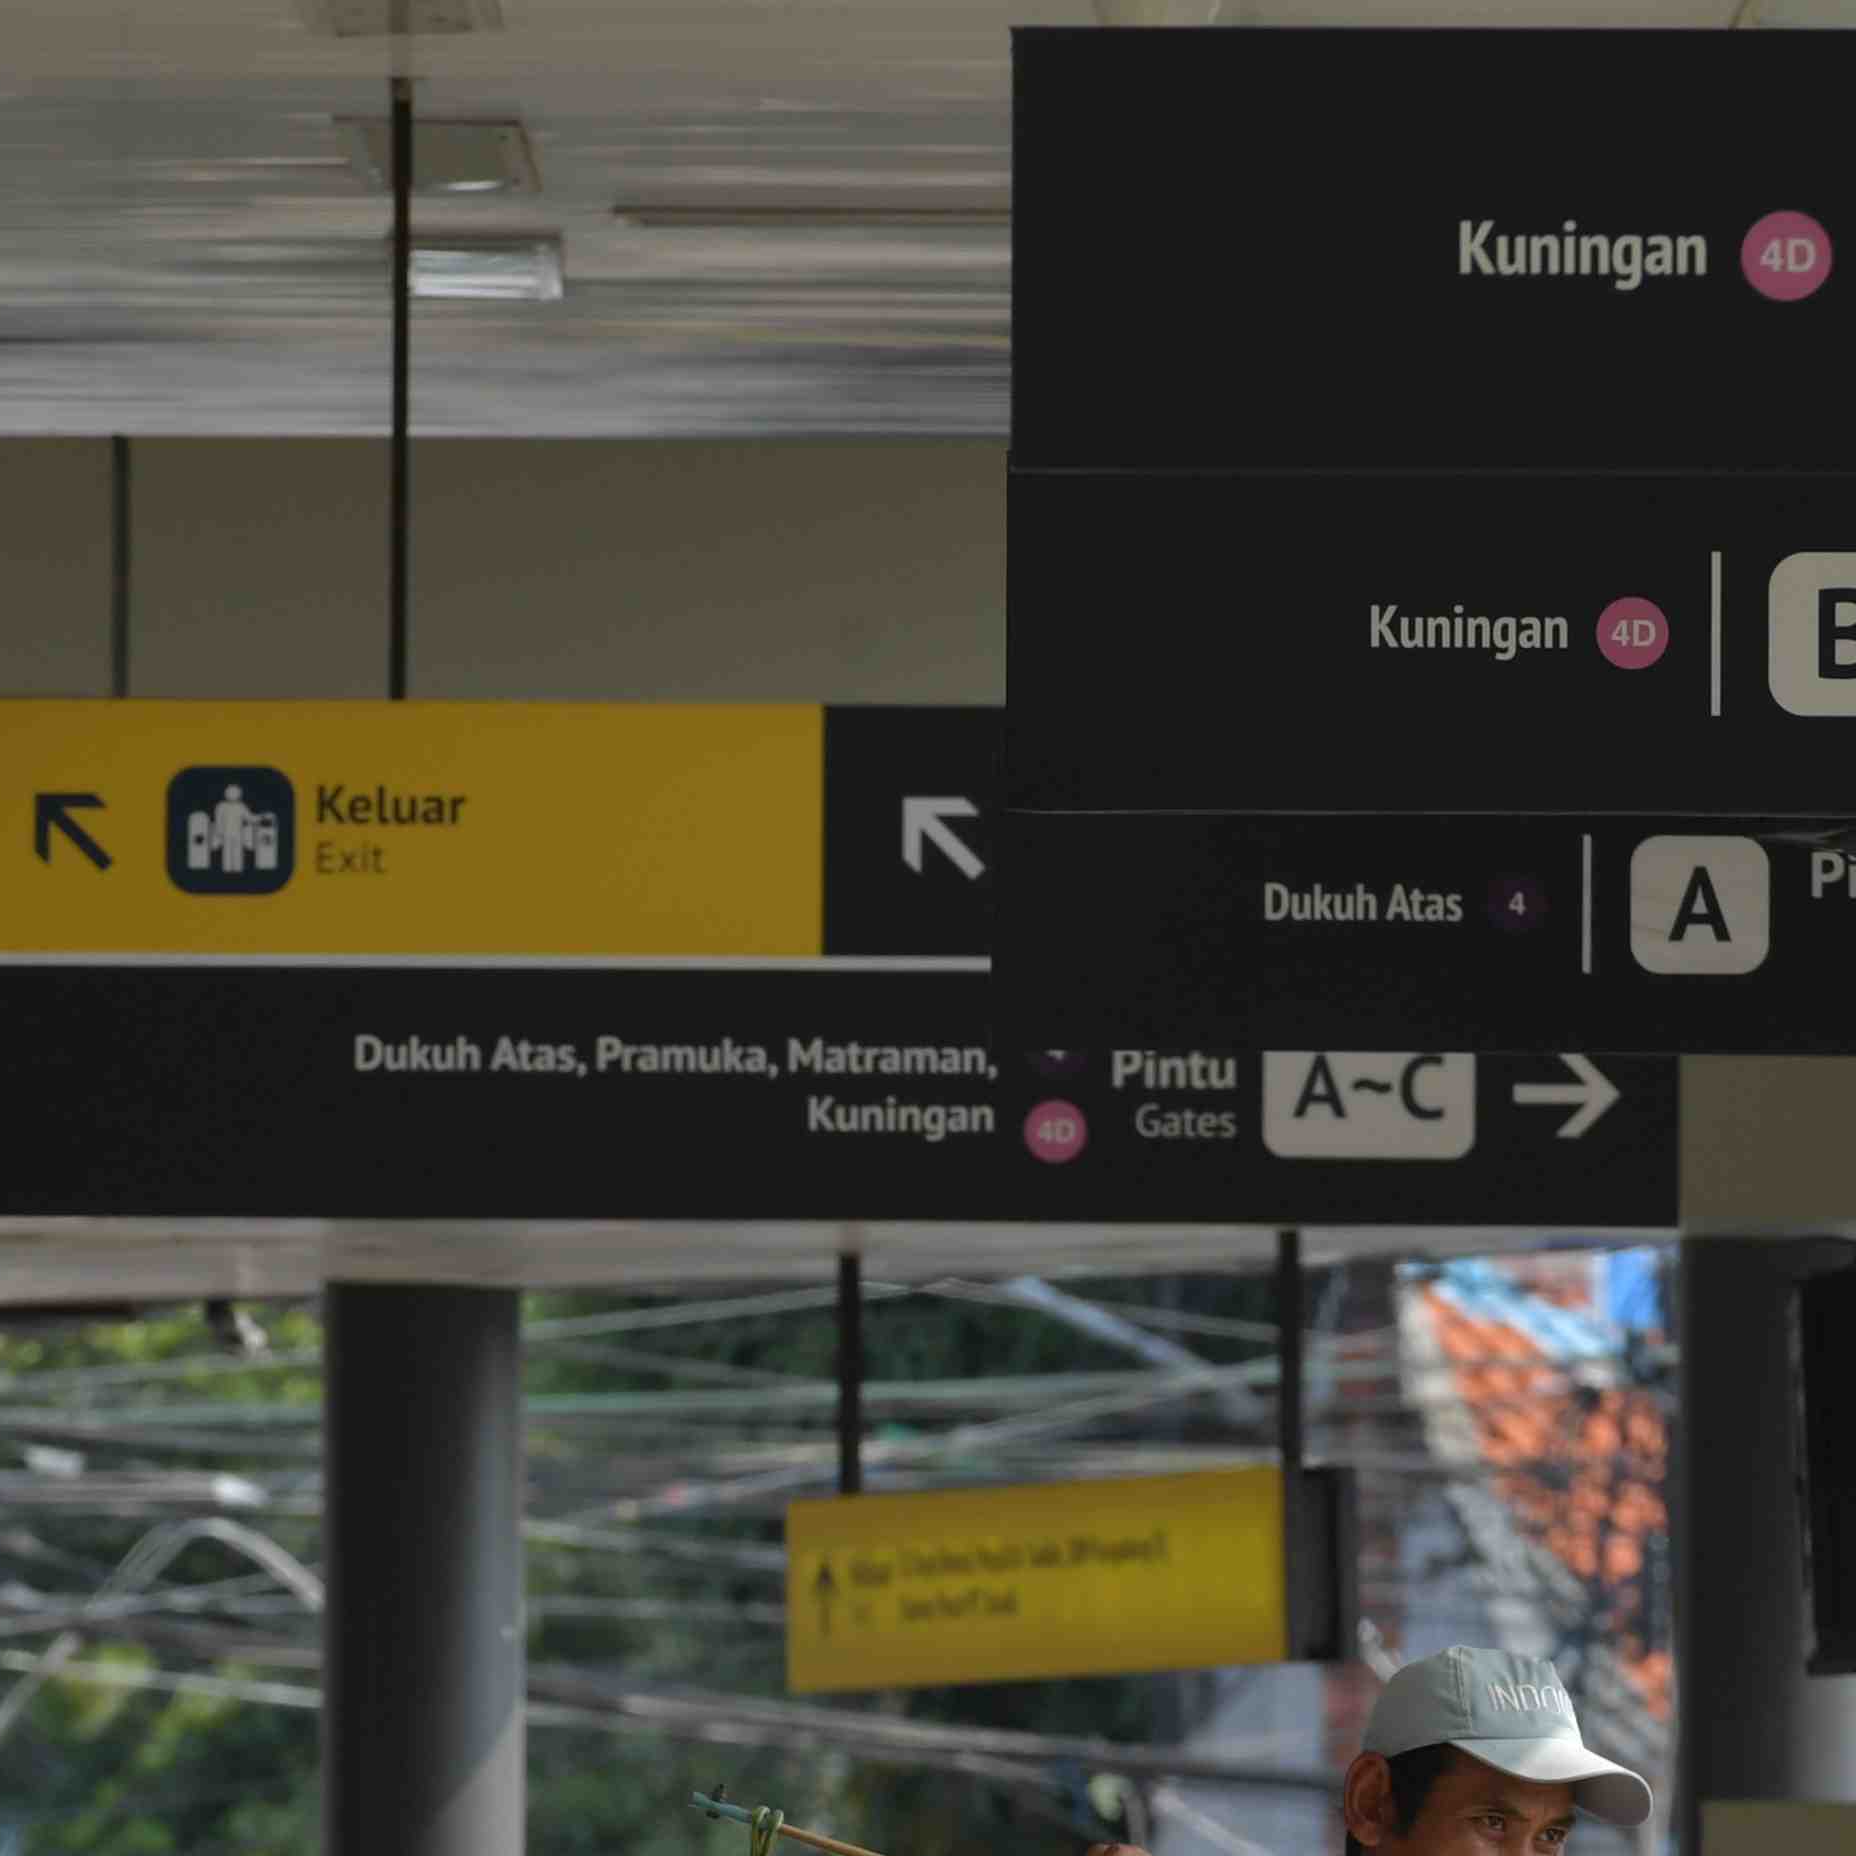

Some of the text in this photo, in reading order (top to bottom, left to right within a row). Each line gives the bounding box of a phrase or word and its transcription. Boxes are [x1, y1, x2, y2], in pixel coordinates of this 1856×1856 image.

[1459, 219, 1817, 290] Kuningan 4D
[1370, 604, 1658, 661] Kuningan 4D
[316, 784, 468, 828] Keluar
[315, 839, 388, 878] Exit
[1264, 883, 1528, 924] Dukuh Atas 4
[1668, 865, 1734, 945] A
[355, 1034, 999, 1082] Dukuh Atas, Pramuka, Matraman,
[1112, 1050, 1238, 1091] Pintu
[807, 1096, 1078, 1145] Kuningan 4D
[1135, 1102, 1239, 1141] Gates
